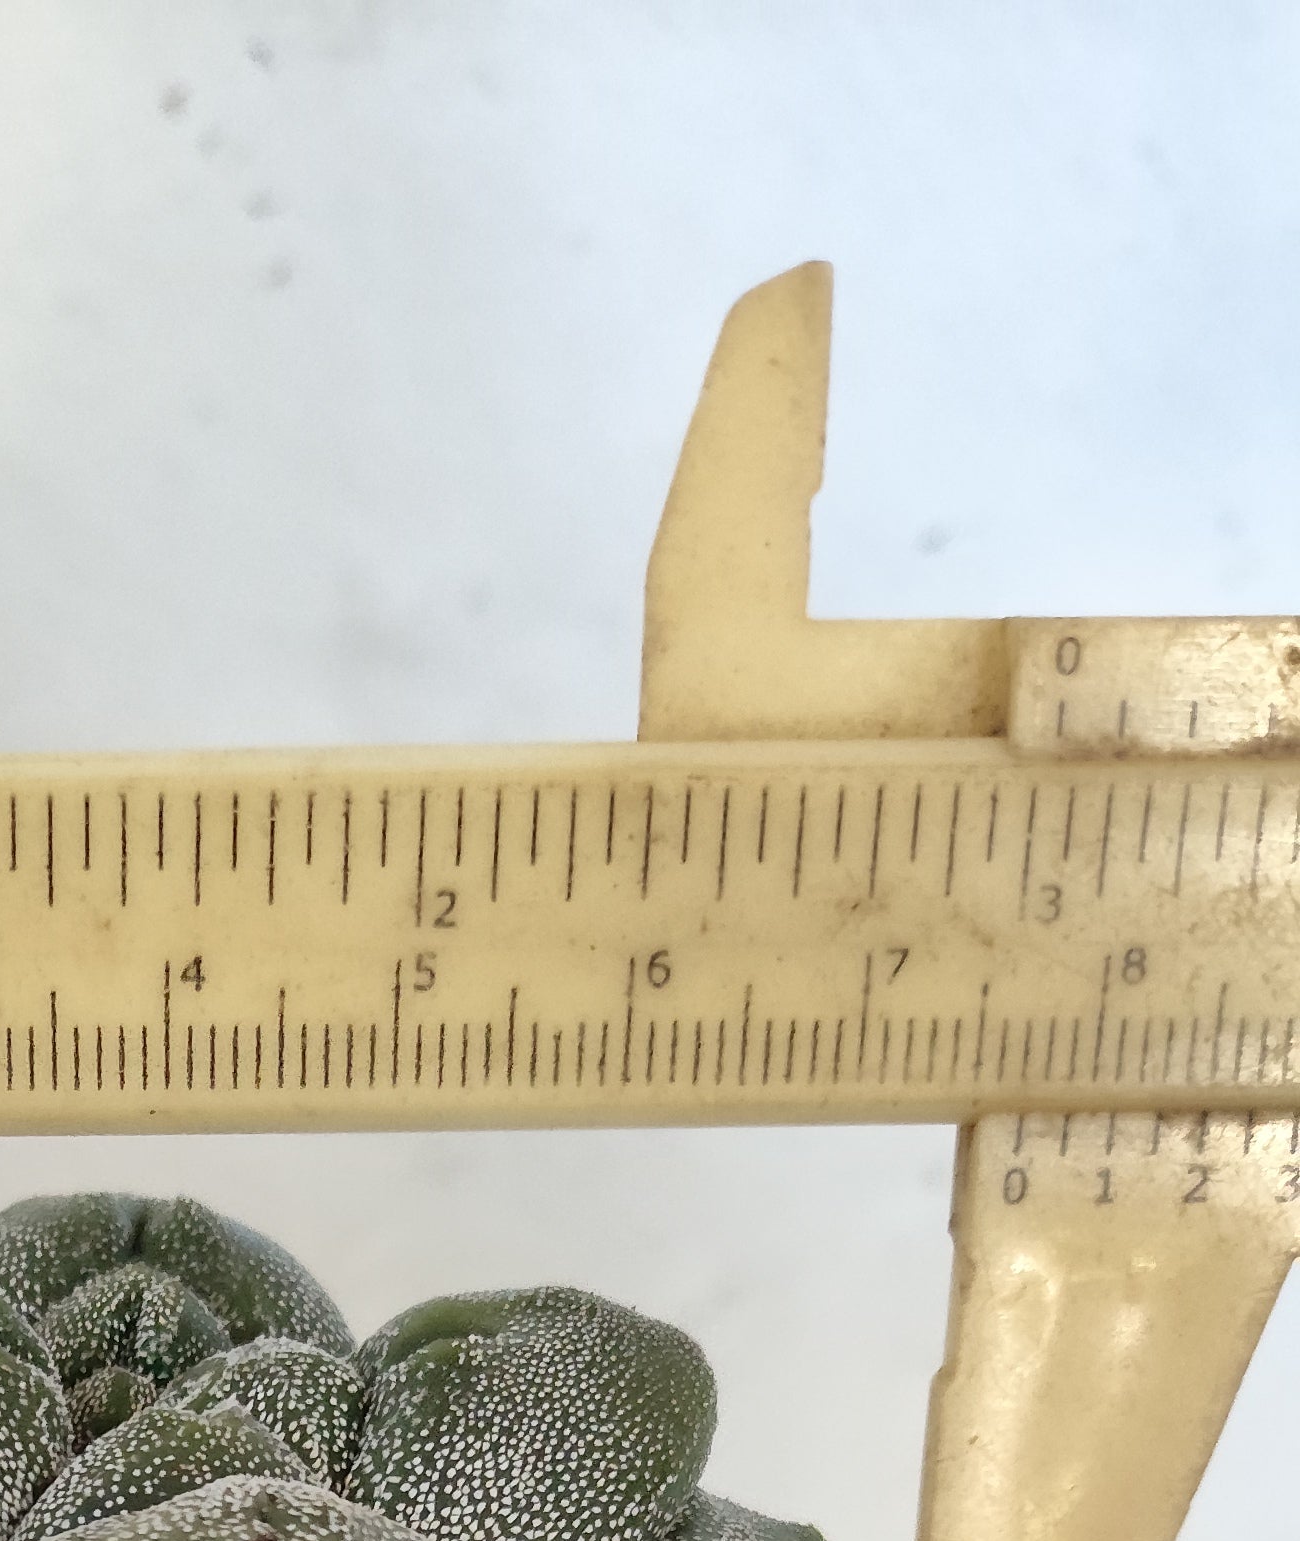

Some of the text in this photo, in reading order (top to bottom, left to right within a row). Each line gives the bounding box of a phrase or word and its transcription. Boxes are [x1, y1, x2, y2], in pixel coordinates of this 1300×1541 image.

[1055, 636, 1082, 676] 0
[432, 889, 457, 928] 2
[1035, 884, 1062, 926] 3
[179, 954, 206, 992] 4
[413, 951, 437, 992] 5
[647, 949, 672, 988] 6
[886, 947, 909, 984] 7
[1121, 947, 1148, 985] 8
[1002, 1166, 1029, 1206] 0
[1094, 1166, 1114, 1204] 1
[1184, 1163, 1208, 1204] 2
